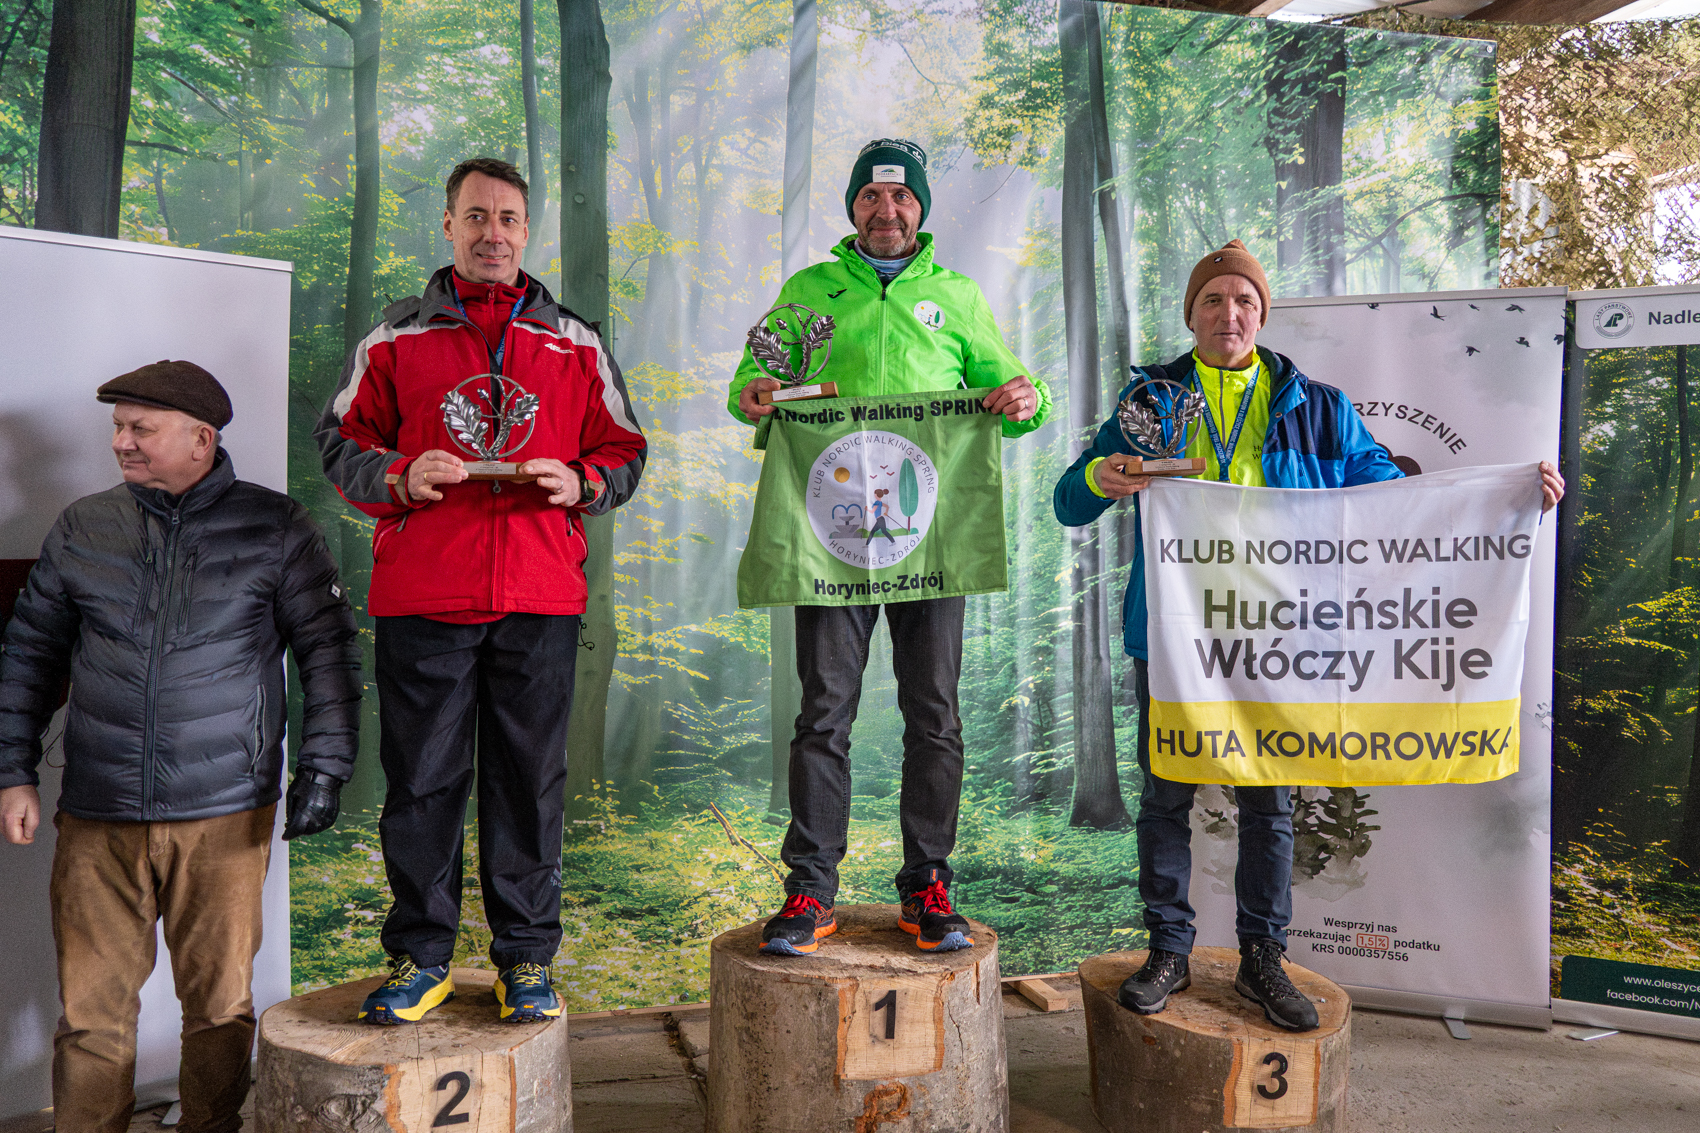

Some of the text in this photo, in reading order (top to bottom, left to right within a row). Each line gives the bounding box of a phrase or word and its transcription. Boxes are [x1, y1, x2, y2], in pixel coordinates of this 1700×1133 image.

[1594, 308, 1604, 321] LASY
[1648, 309, 1700, 326] Nadle
[785, 408, 846, 424] Nordic
[852, 402, 925, 422] Walking
[930, 398, 992, 417] SPRIN
[813, 435, 935, 498] KLUB NORDIC WALKING SPRING
[829, 535, 921, 566] HORYNIEC-ZDRÓJ
[1160, 534, 1532, 565] KLUB NORDIC WALKING
[814, 571, 944, 599] Horyniec-Zdrój
[1204, 587, 1478, 631] Hucieńskie
[1194, 636, 1493, 692] Włóczy Kije
[1156, 727, 1246, 759] HUTA
[1286, 928, 1352, 943] przekazując
[1393, 938, 1441, 952] podatku
[1323, 916, 1398, 933] Wesprzyj nas
[1311, 943, 1409, 962] KRS 0000357556
[874, 989, 897, 1040] 1
[1257, 1051, 1289, 1100] 3
[432, 1071, 471, 1128] 2
